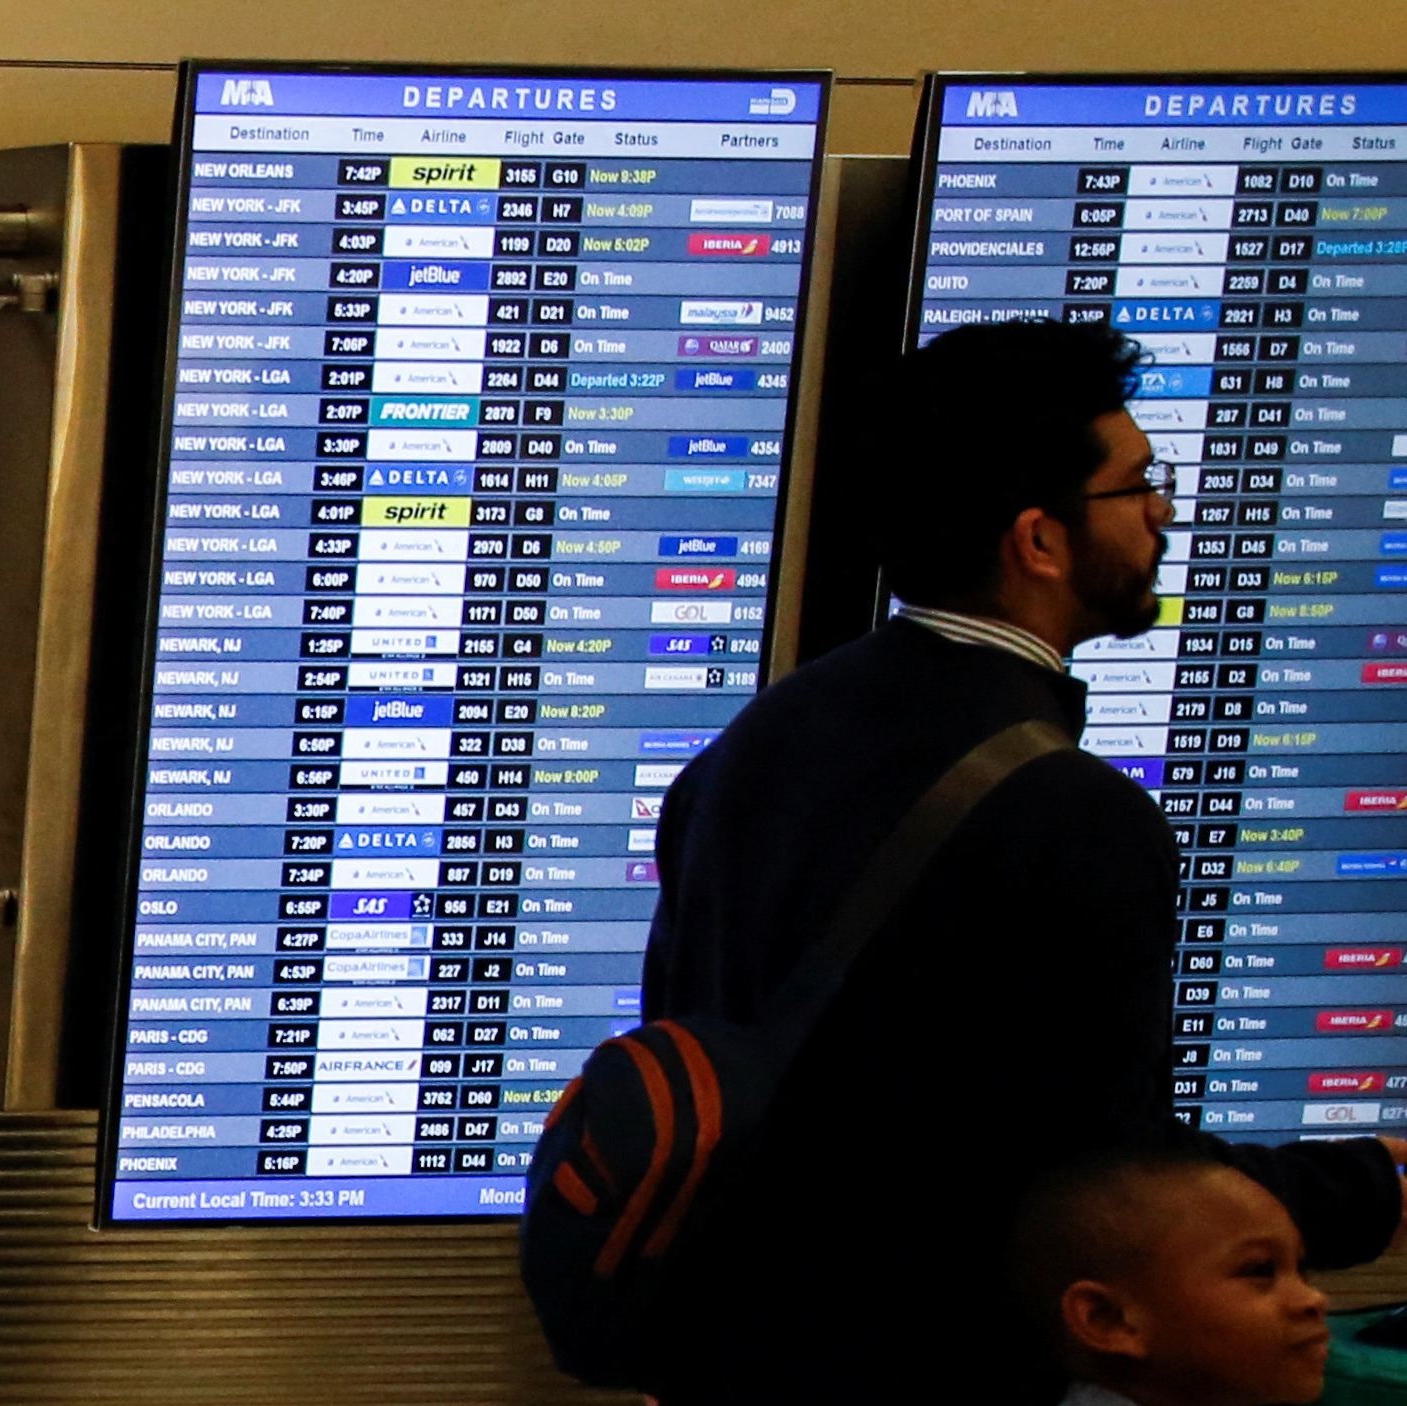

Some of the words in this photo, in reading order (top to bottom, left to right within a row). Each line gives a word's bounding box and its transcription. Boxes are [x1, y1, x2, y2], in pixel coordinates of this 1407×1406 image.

[404, 87, 615, 110] DEPARTURES
[1145, 95, 1355, 116] DEPARTURES
[230, 126, 309, 140] Destination
[353, 128, 384, 141] Time
[422, 130, 466, 142] Airline
[505, 131, 543, 147] Flight
[554, 132, 584, 144] Gate
[615, 133, 658, 145] Status
[721, 134, 778, 147] Partners
[975, 138, 1051, 150] Destination
[1094, 138, 1124, 150] Time
[1161, 138, 1205, 150] Airline
[1244, 137, 1282, 153] Flight
[1291, 137, 1322, 149] Gate
[1353, 137, 1395, 149] Status
[195, 163, 227, 177] NEW
[229, 164, 293, 178] ORLEANS
[346, 166, 381, 180] 7:42P
[413, 164, 475, 184] spirit
[506, 169, 535, 182] 3155
[553, 170, 578, 183] G10
[590, 170, 618, 182] Now
[939, 175, 996, 187] PHOENIX
[1086, 176, 1120, 188] 7:43P
[1290, 175, 1313, 187] D10
[1327, 174, 1344, 186] On
[1350, 174, 1378, 186] Time
[928, 276, 968, 289] QUITO
[380, 403, 469, 419] FRONTIER
[1183, 1020, 1203, 1031] E11
[125, 1094, 204, 1107] PENSACOLA
[133, 1192, 197, 1208] Current
[199, 1192, 245, 1208] Local
[249, 1192, 295, 1207] Time:
[299, 1191, 334, 1206] 3:33
[339, 1190, 364, 1205] PM
[479, 1187, 526, 1204] Mond
